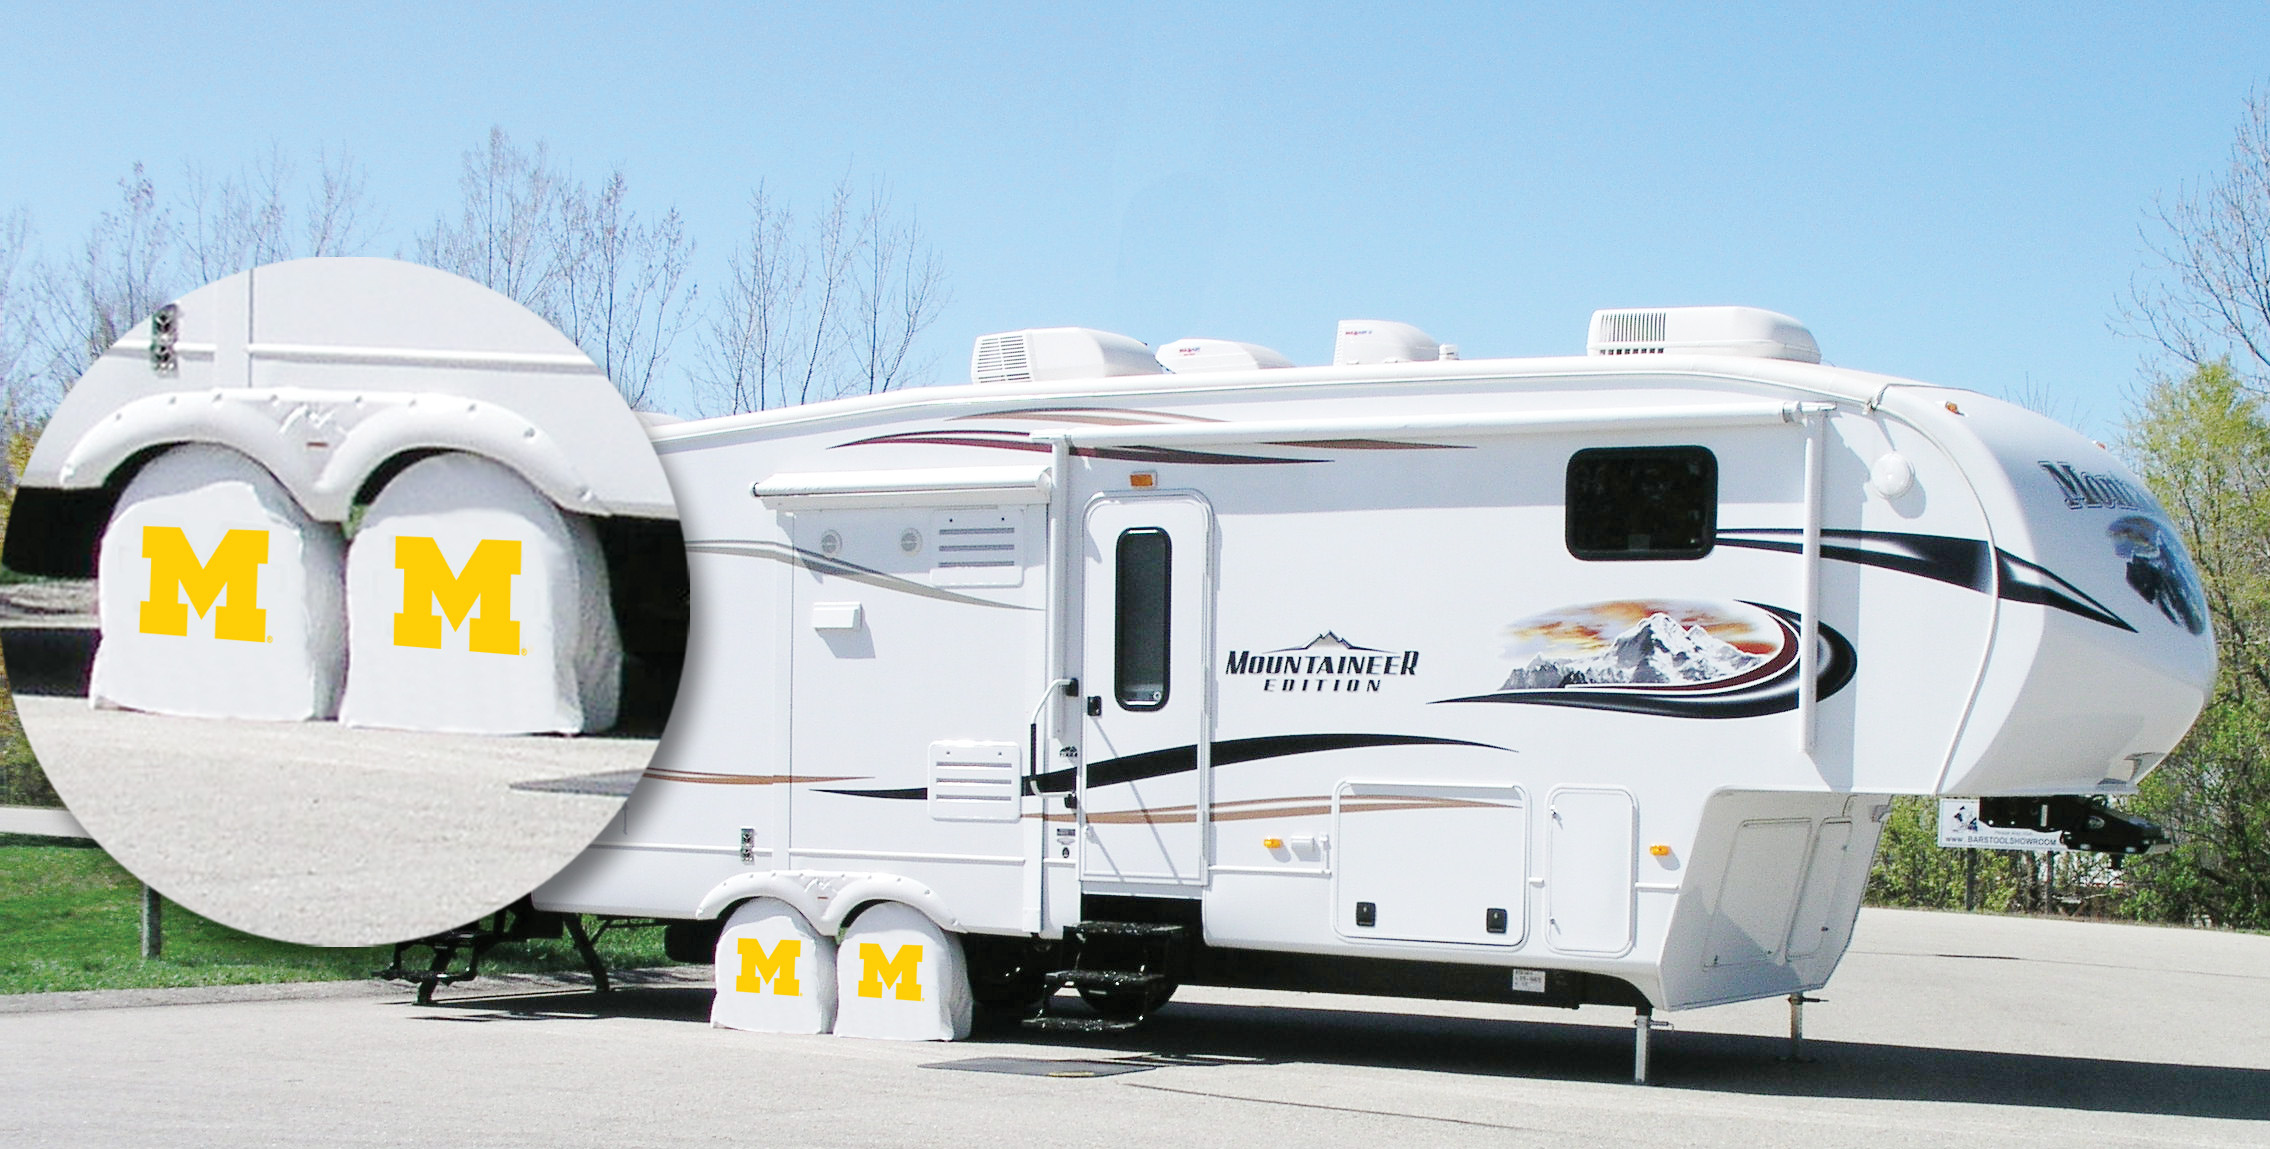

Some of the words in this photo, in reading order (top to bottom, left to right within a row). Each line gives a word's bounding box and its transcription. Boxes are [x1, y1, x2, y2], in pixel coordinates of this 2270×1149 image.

[139, 525, 270, 643] M
[393, 535, 523, 656] M
[1225, 650, 1420, 676] MOUNTAINEER
[1263, 678, 1381, 692] EDITION
[735, 937, 801, 997] M
[857, 942, 923, 1002] M
